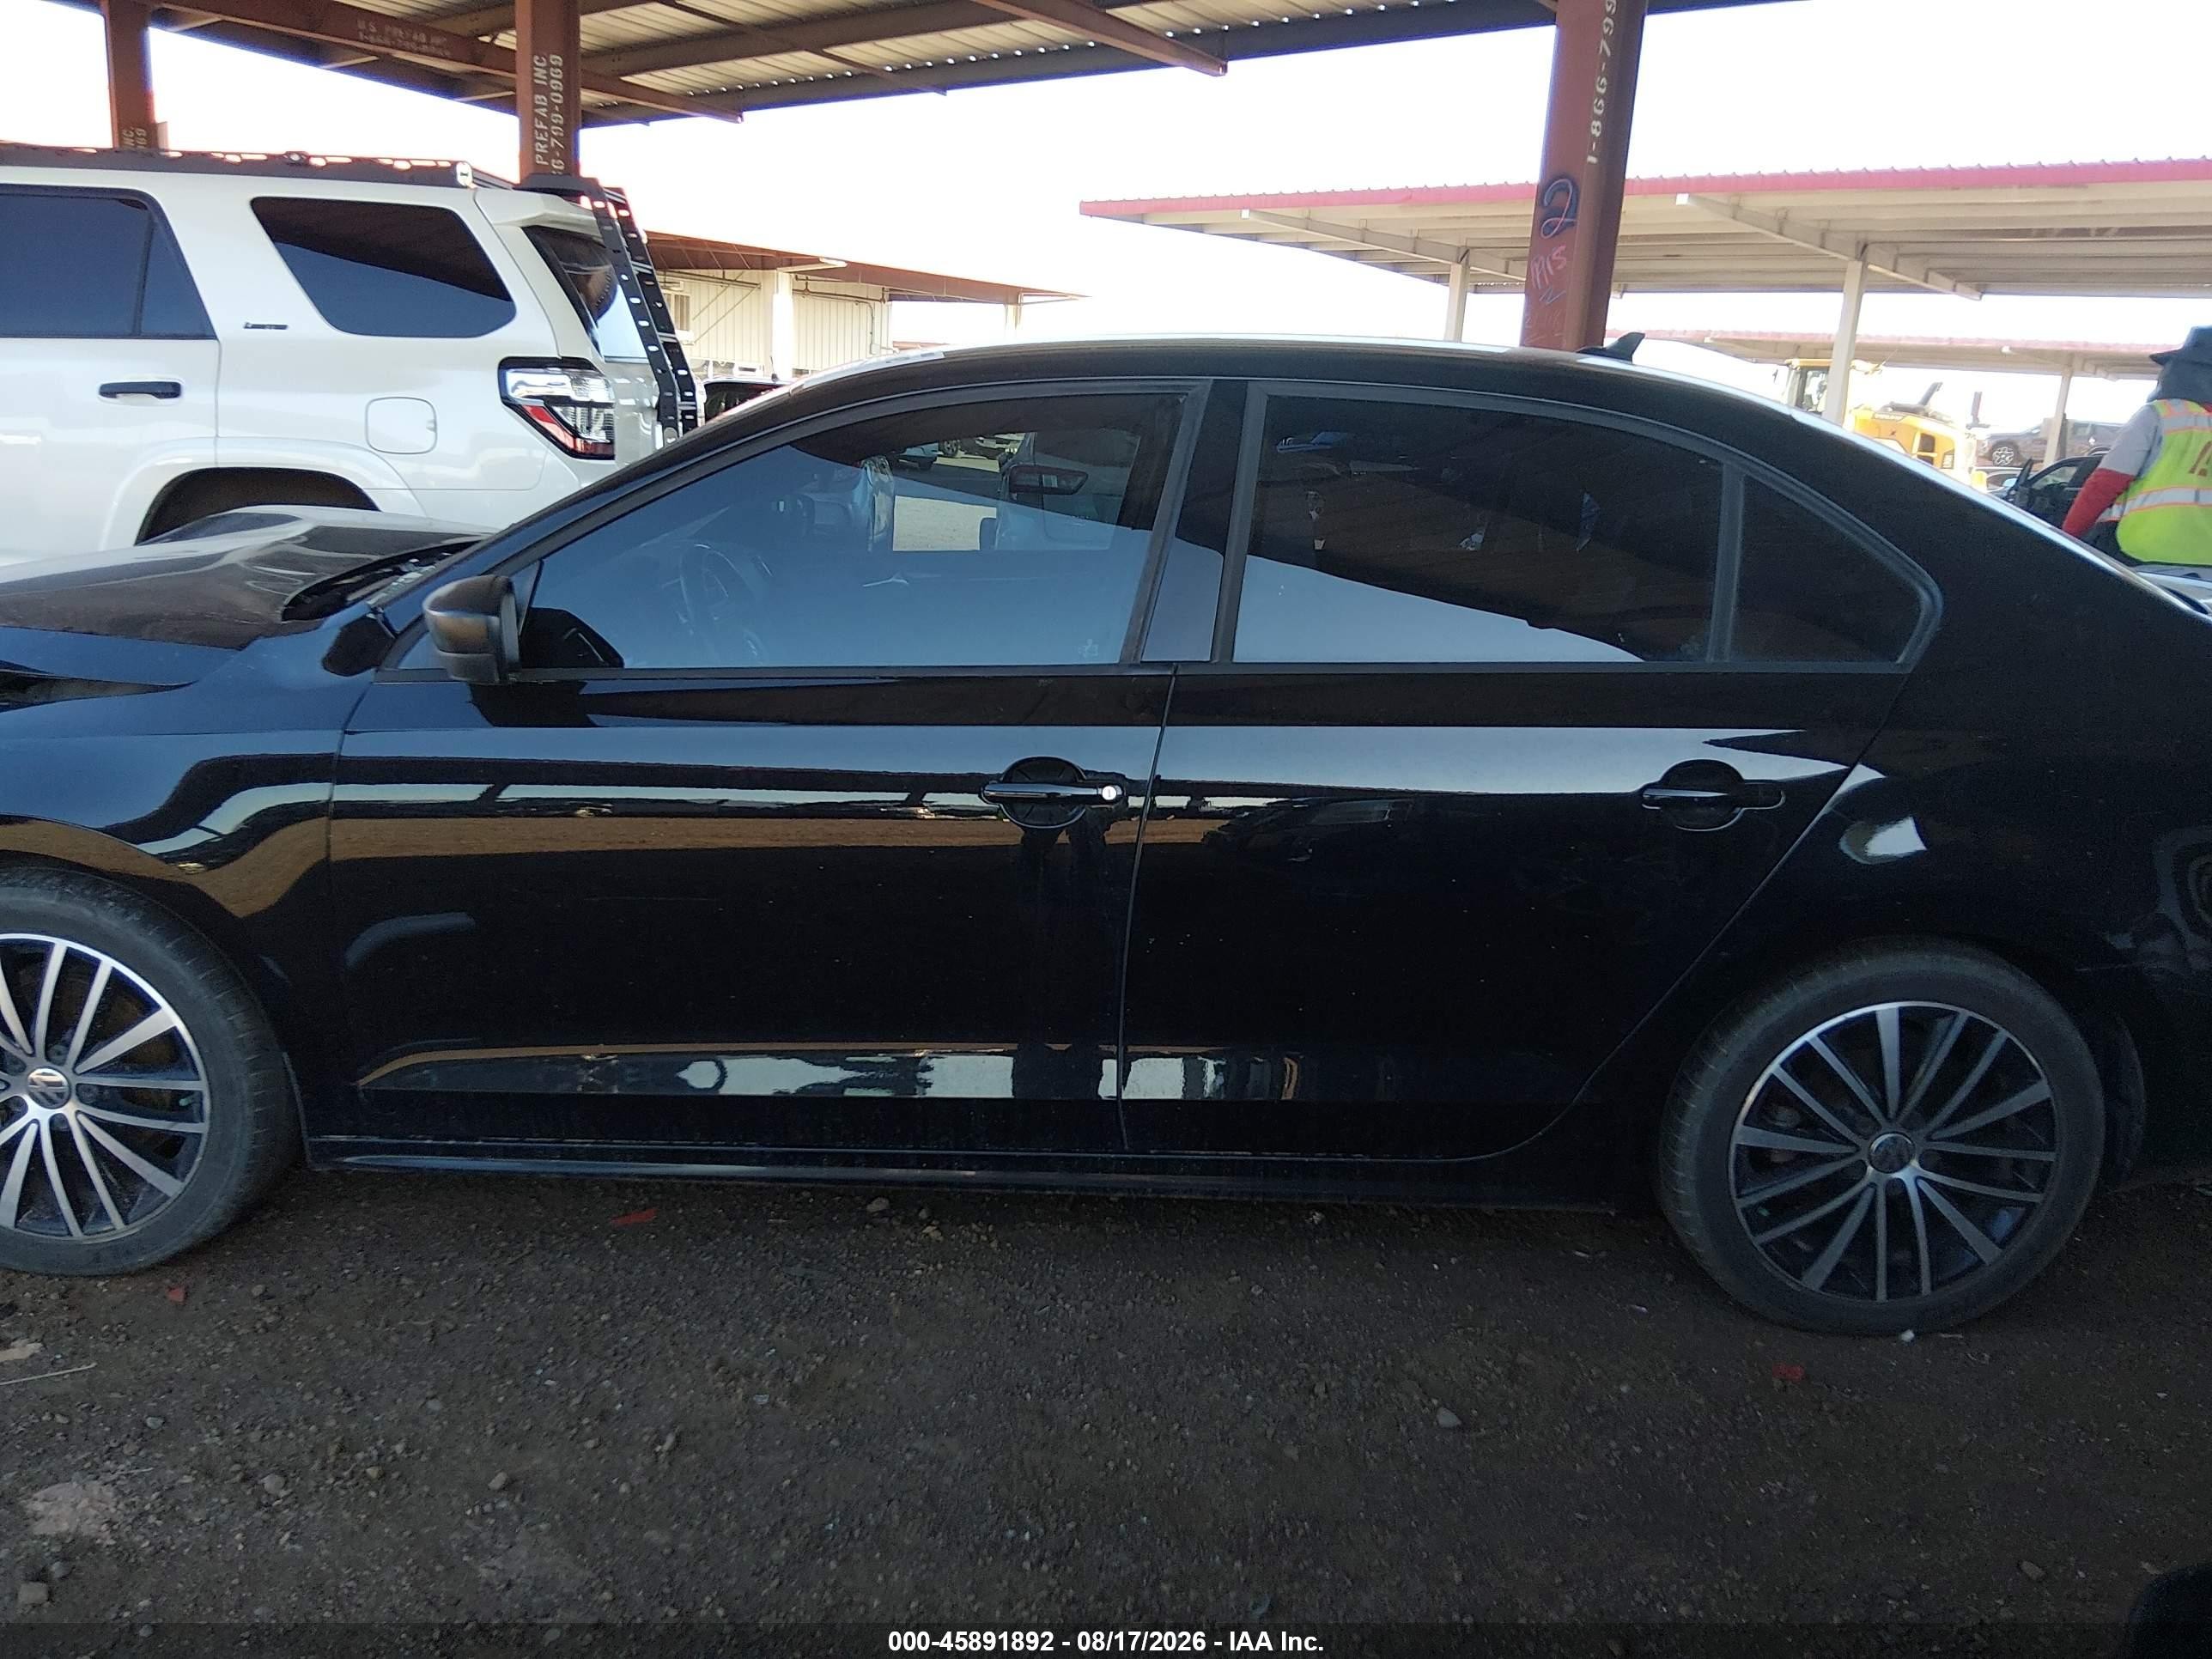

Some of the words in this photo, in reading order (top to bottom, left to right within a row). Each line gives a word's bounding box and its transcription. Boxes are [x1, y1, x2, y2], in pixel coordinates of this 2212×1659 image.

[533, 55, 548, 86] INC
[534, 94, 550, 166] PREFAB
[1540, 176, 1580, 239] 2
